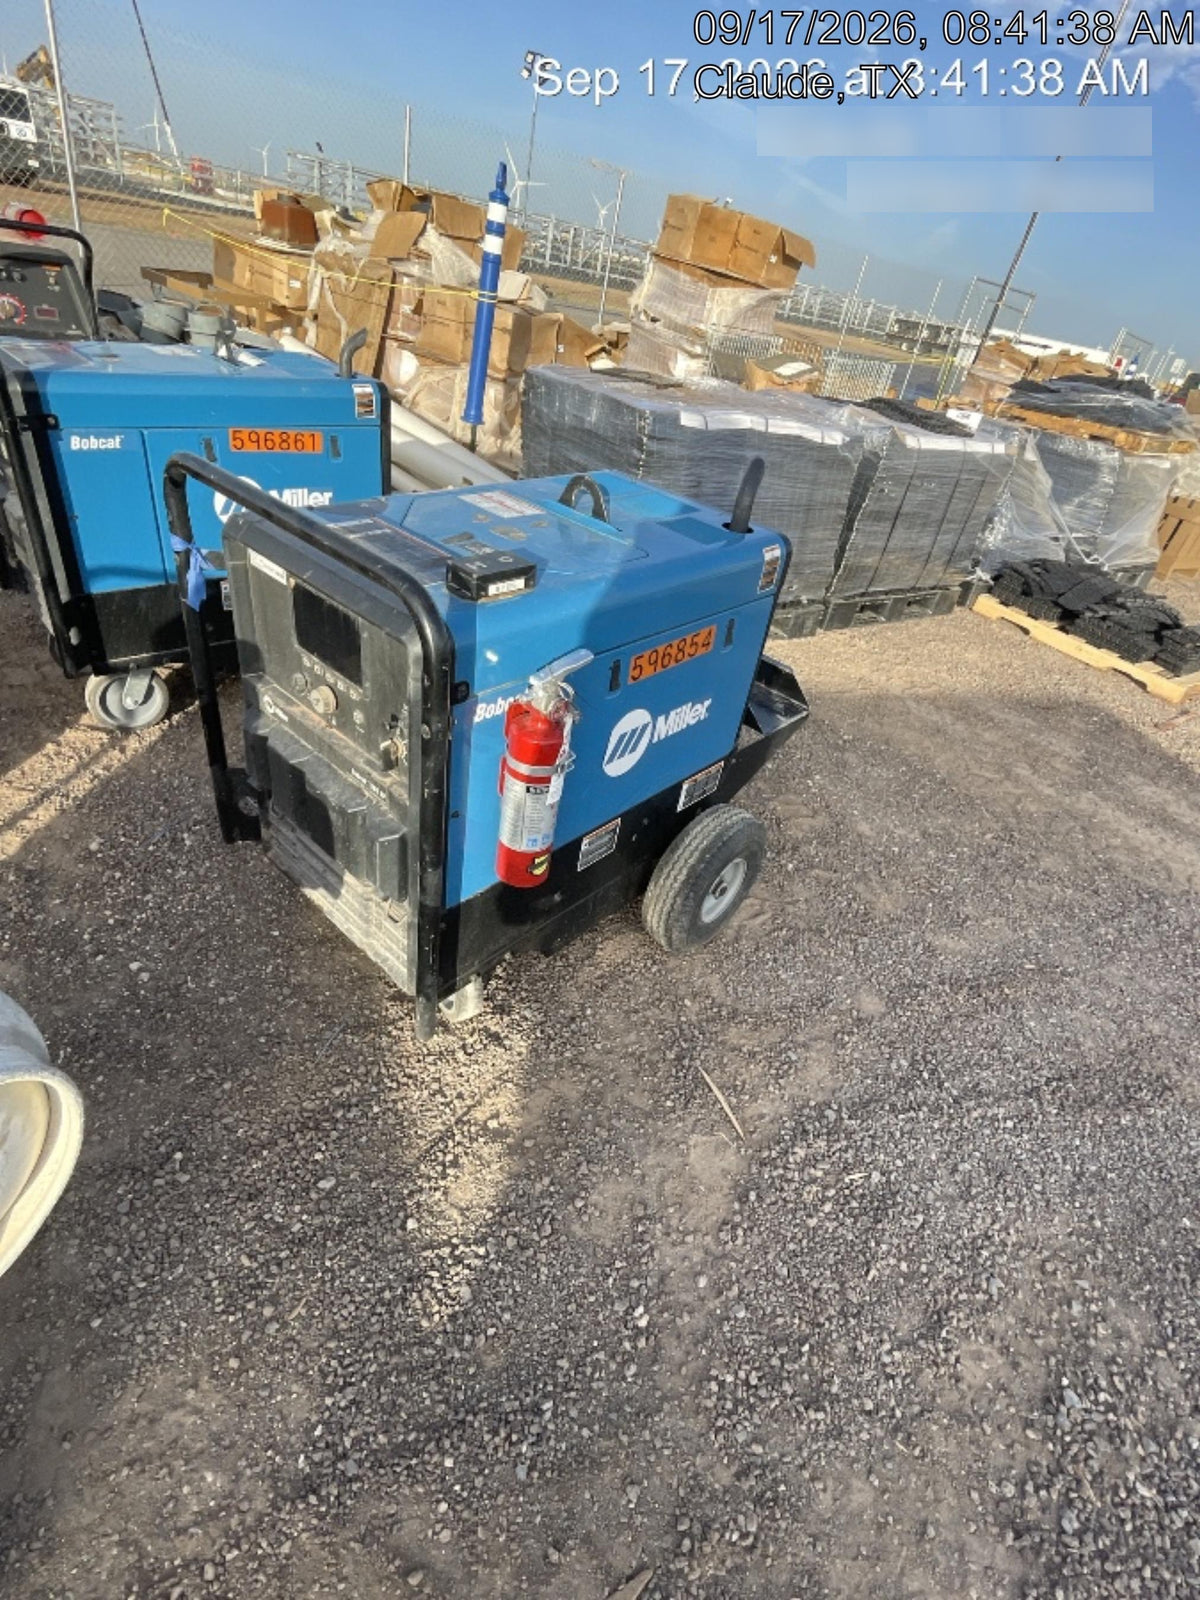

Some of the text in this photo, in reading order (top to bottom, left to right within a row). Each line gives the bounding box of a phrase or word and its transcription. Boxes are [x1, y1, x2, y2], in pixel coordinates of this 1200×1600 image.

[70, 434, 122, 450] Bobcat
[231, 430, 317, 451] 596861
[629, 628, 712, 682] 596854
[652, 698, 712, 744] Miller
